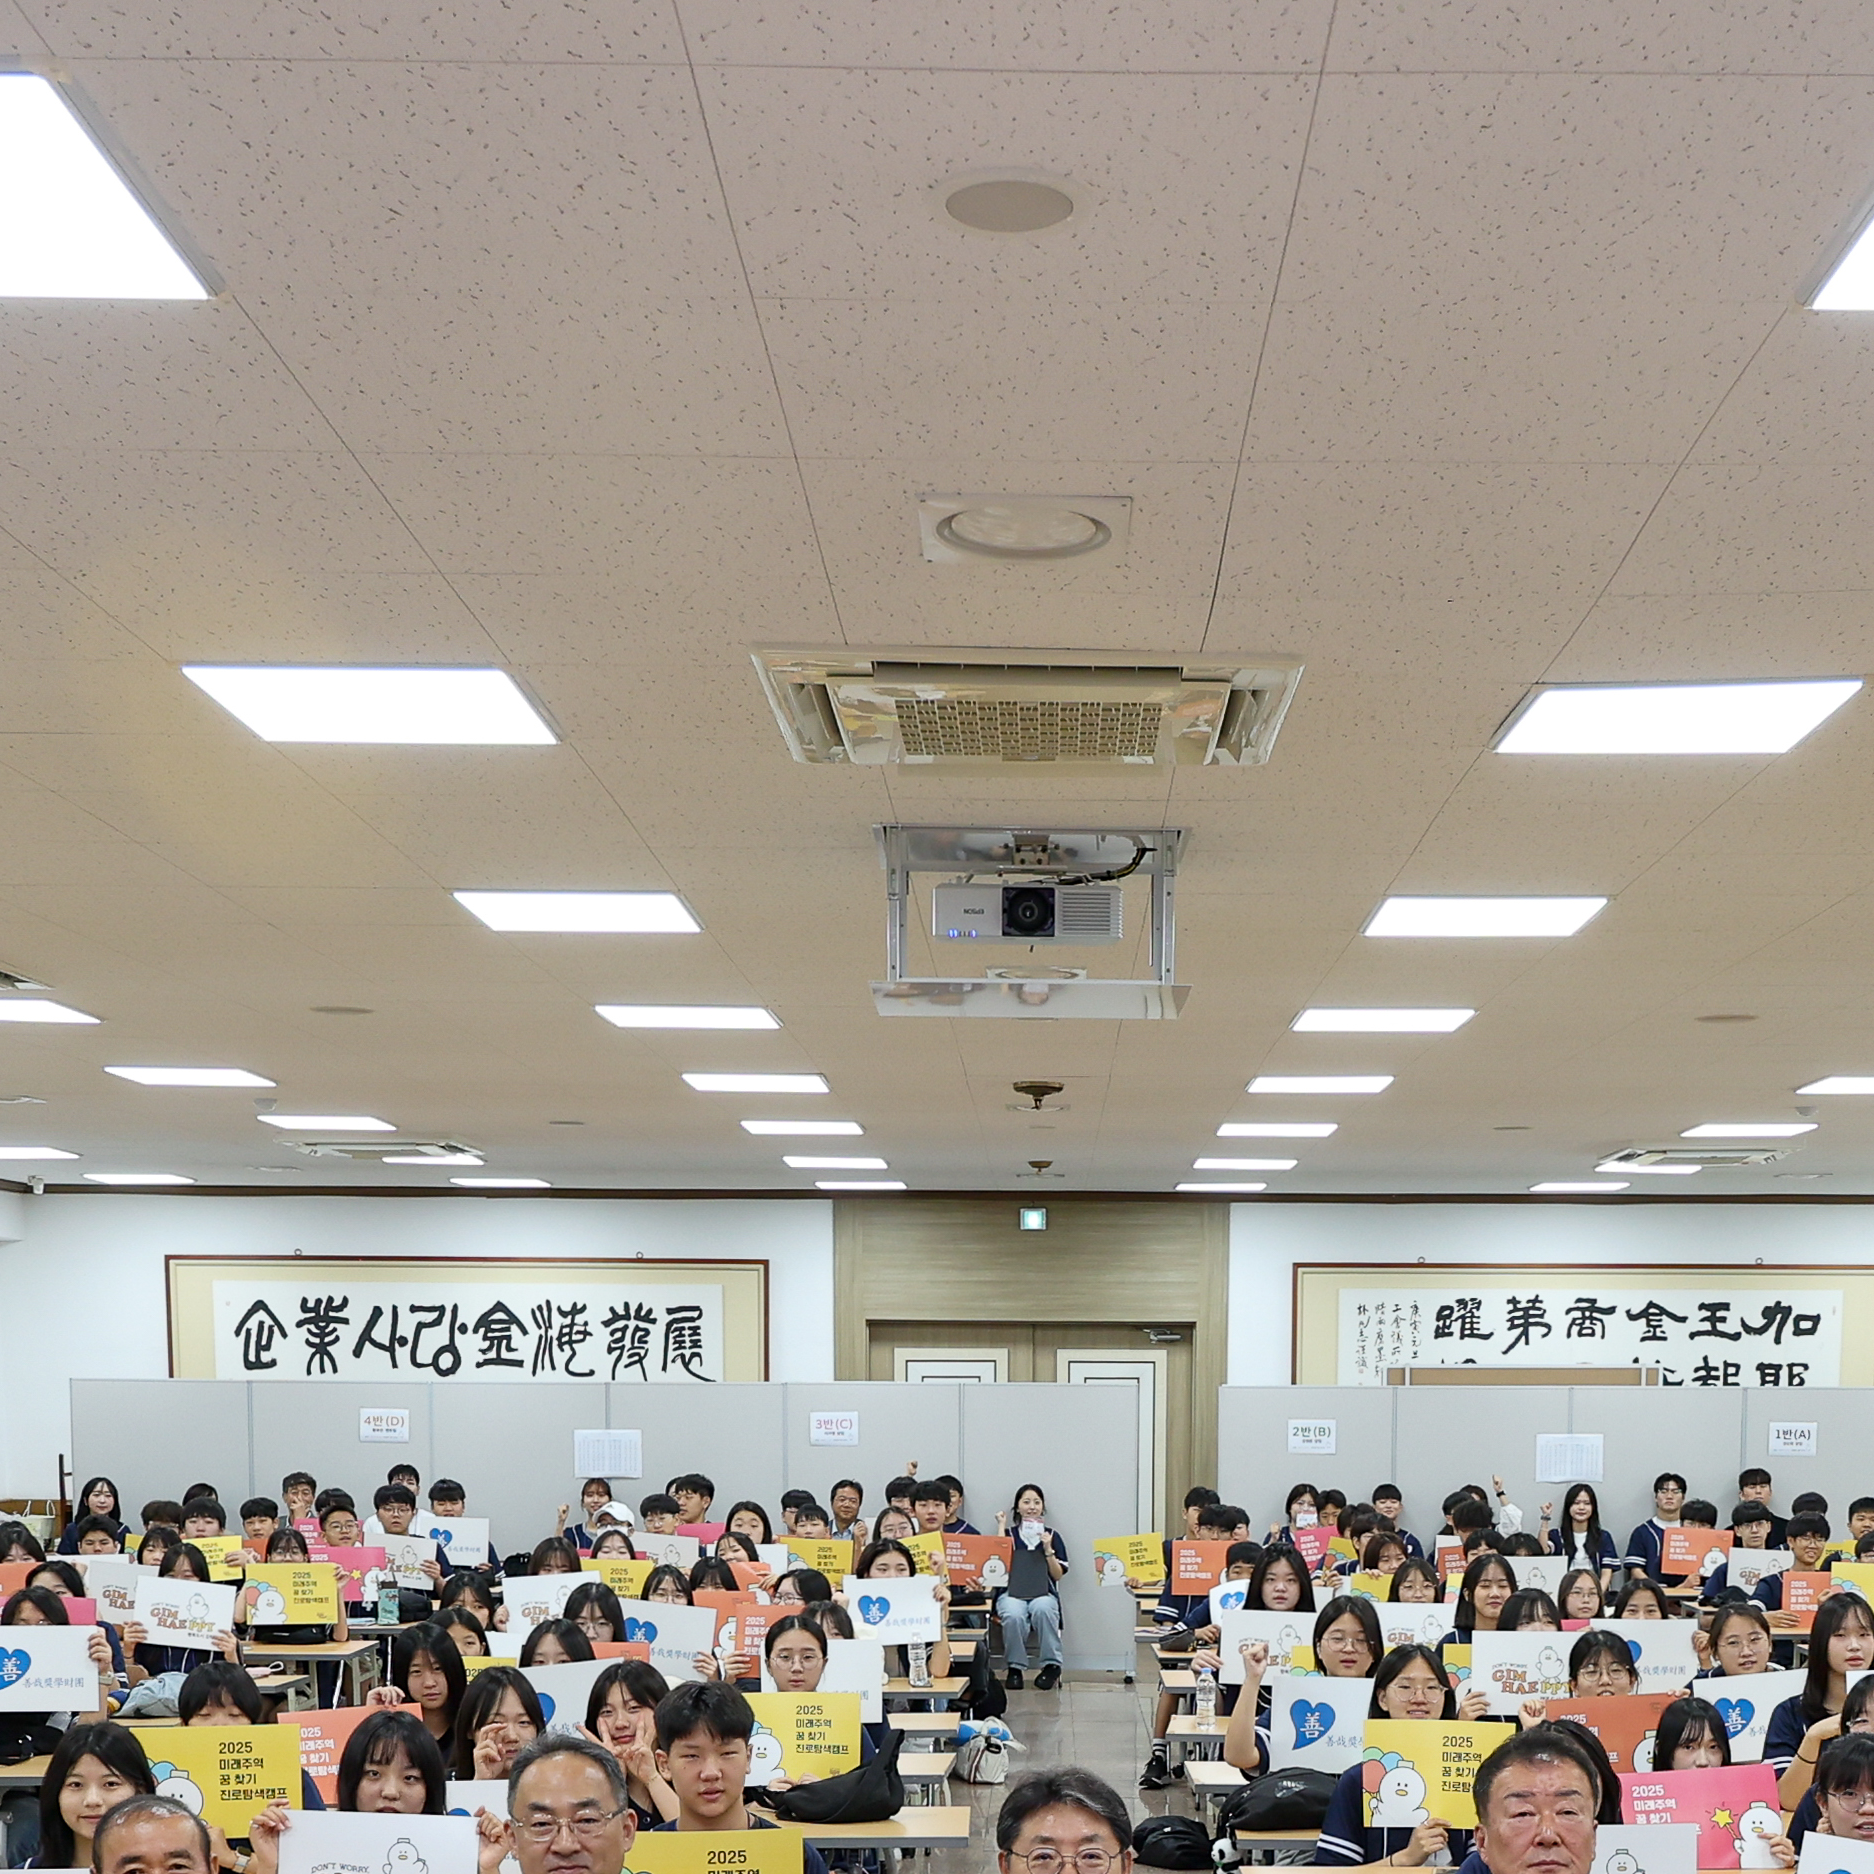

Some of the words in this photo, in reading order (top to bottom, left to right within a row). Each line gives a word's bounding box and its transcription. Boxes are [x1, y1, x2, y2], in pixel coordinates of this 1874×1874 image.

[1293, 1427, 1331, 1437] 2반(B)
[1776, 1430, 1810, 1440] 1반(A)
[796, 1706, 823, 1715] 2025
[796, 1719, 831, 1728] 미래주역
[1300, 1711, 1324, 1738] 善
[1727, 1710, 1745, 1733] 善
[797, 1732, 804, 1740] 꿈
[808, 1732, 825, 1740] 찾기
[1443, 1736, 1472, 1748] 2025
[796, 1744, 849, 1754] 진로탐색캠프
[1442, 1752, 1484, 1764] 미래주역
[1442, 1767, 1451, 1776] 꿈
[708, 1850, 746, 1864] 2025
